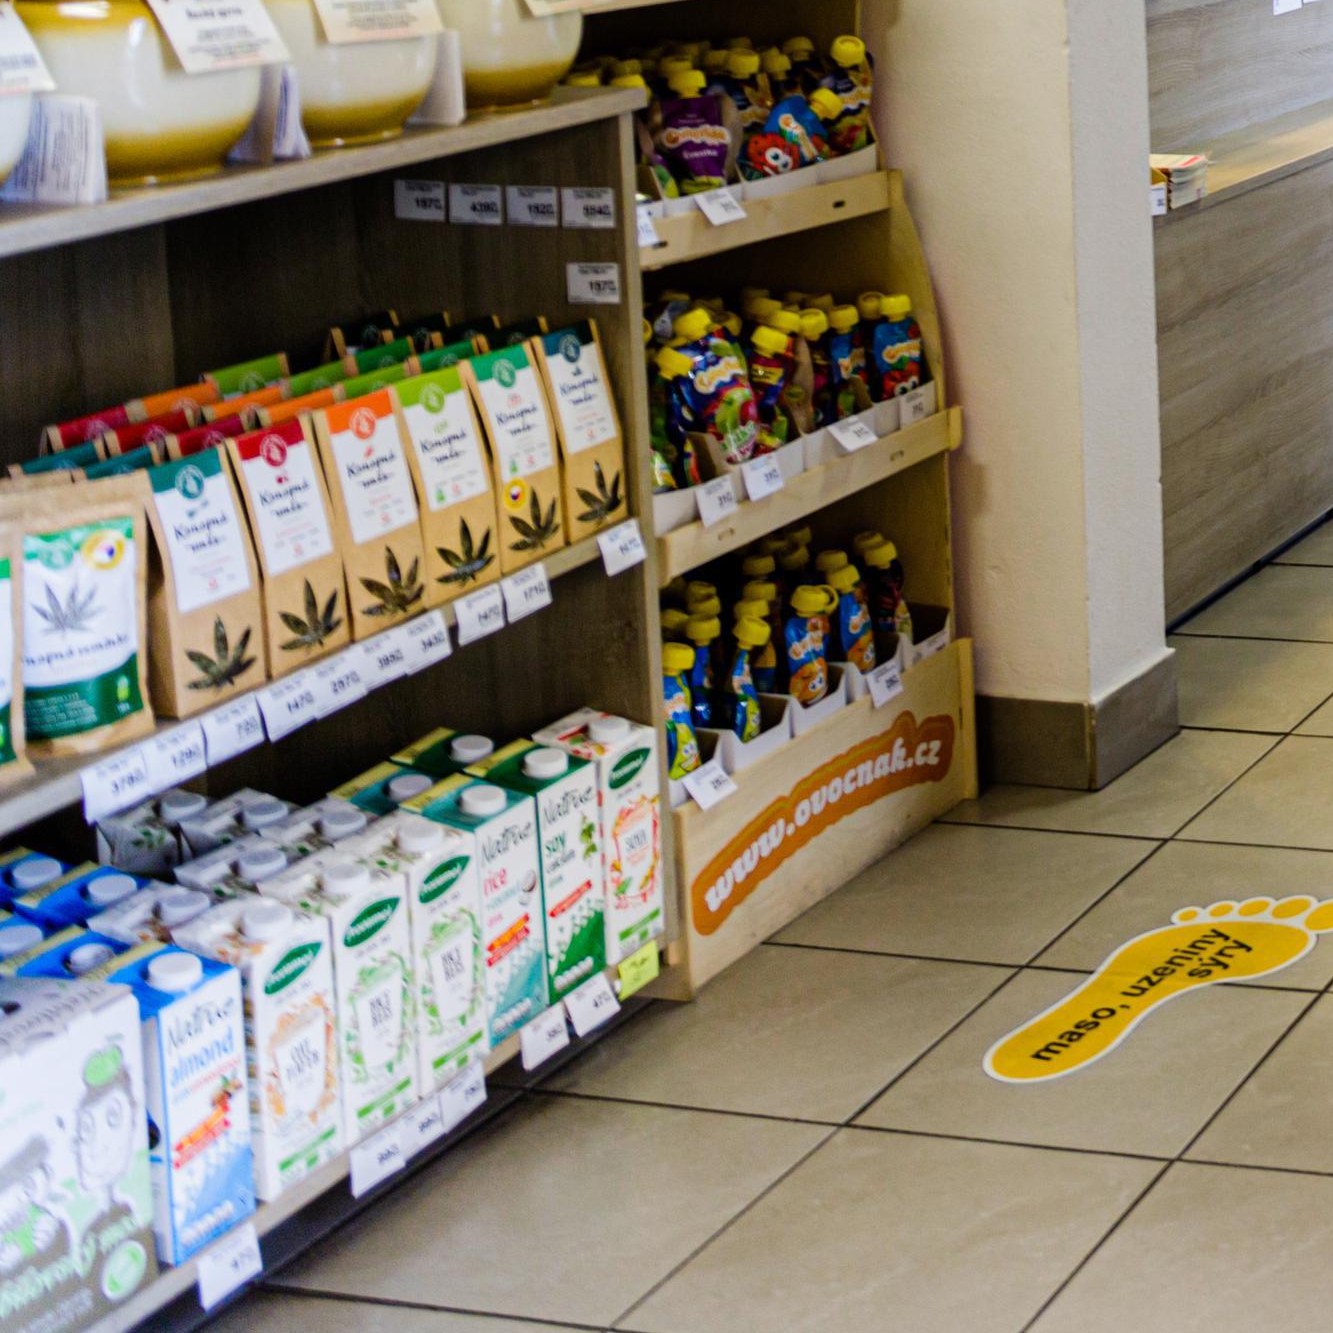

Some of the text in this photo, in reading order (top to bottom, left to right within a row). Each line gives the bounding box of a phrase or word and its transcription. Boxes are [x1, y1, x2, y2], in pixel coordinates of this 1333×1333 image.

[703, 736, 942, 914] www.ovocnak.cz
[1029, 927, 1232, 1063] maso, uzeniny
[1187, 938, 1254, 980] sýry
